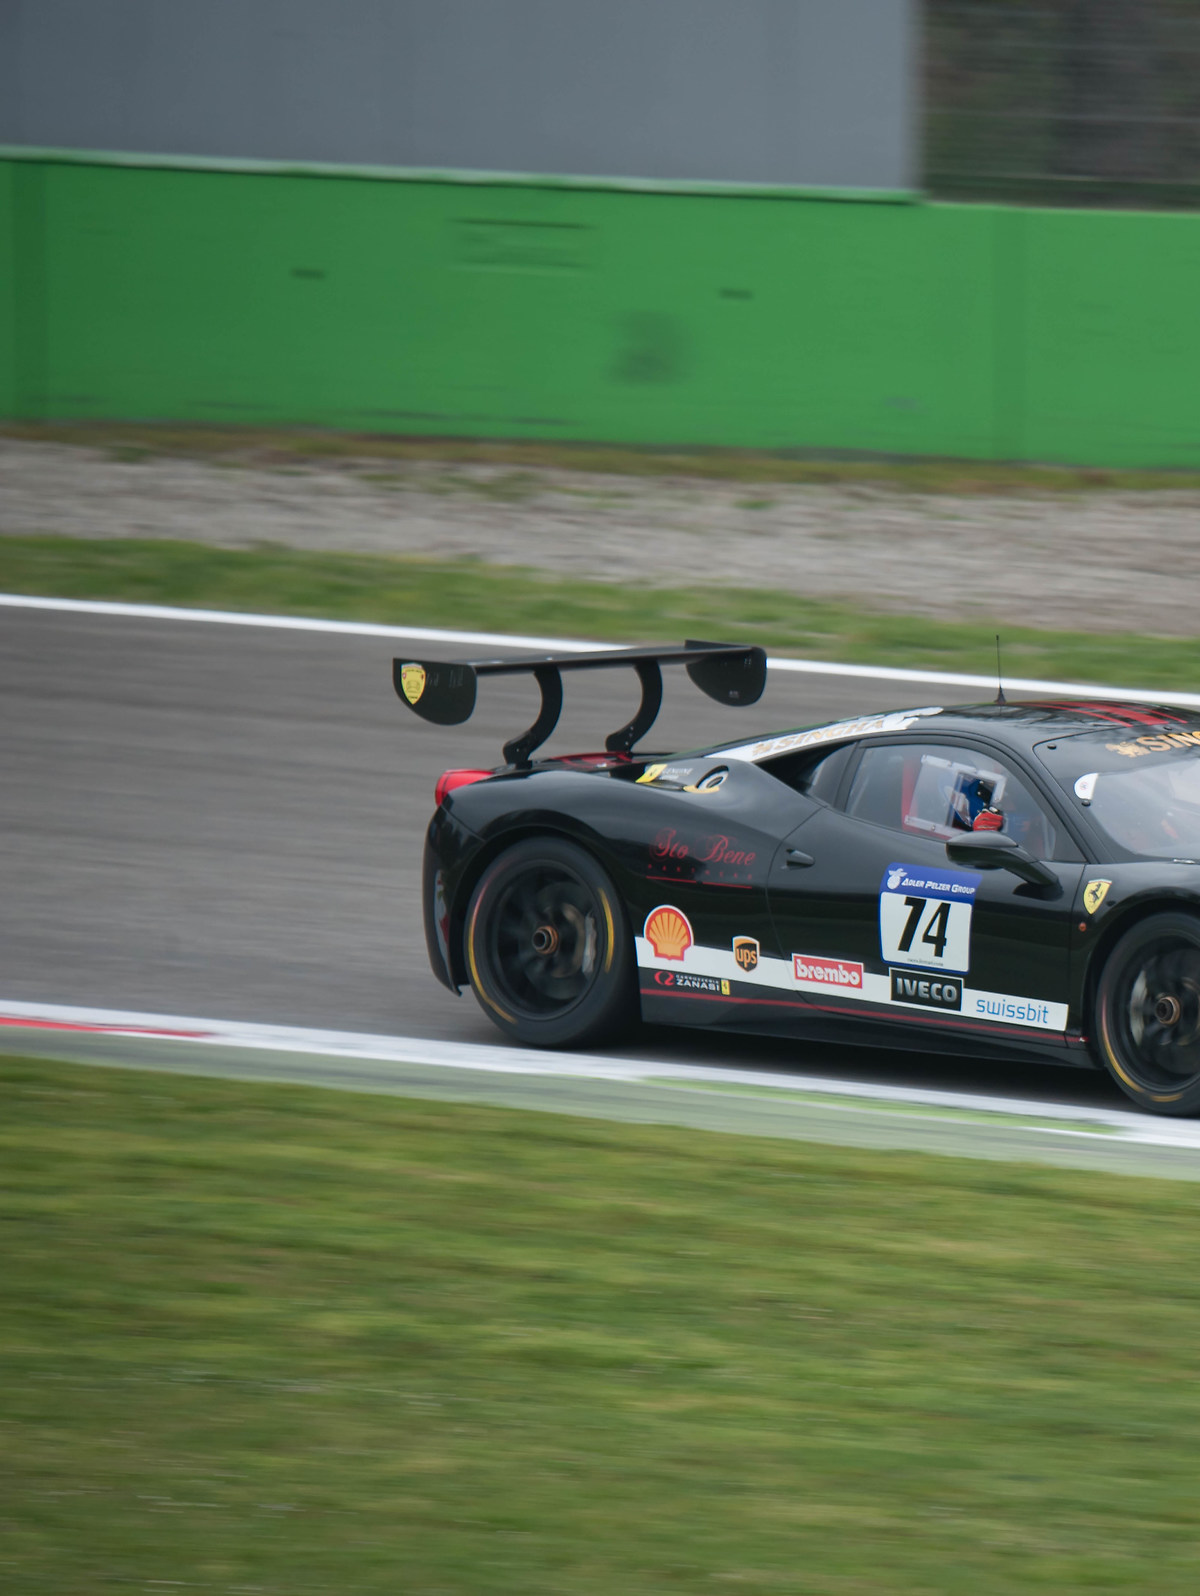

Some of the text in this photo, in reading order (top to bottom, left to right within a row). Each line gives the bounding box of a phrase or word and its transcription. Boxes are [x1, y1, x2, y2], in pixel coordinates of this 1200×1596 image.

[773, 719, 885, 749] SINGHA
[694, 833, 757, 866] Bene
[897, 895, 952, 958] 74
[736, 948, 758, 968] ups
[676, 978, 720, 992] ZANASI
[796, 958, 861, 986] brembo
[895, 977, 958, 1003] IVECO
[975, 999, 1049, 1024] swissbit
